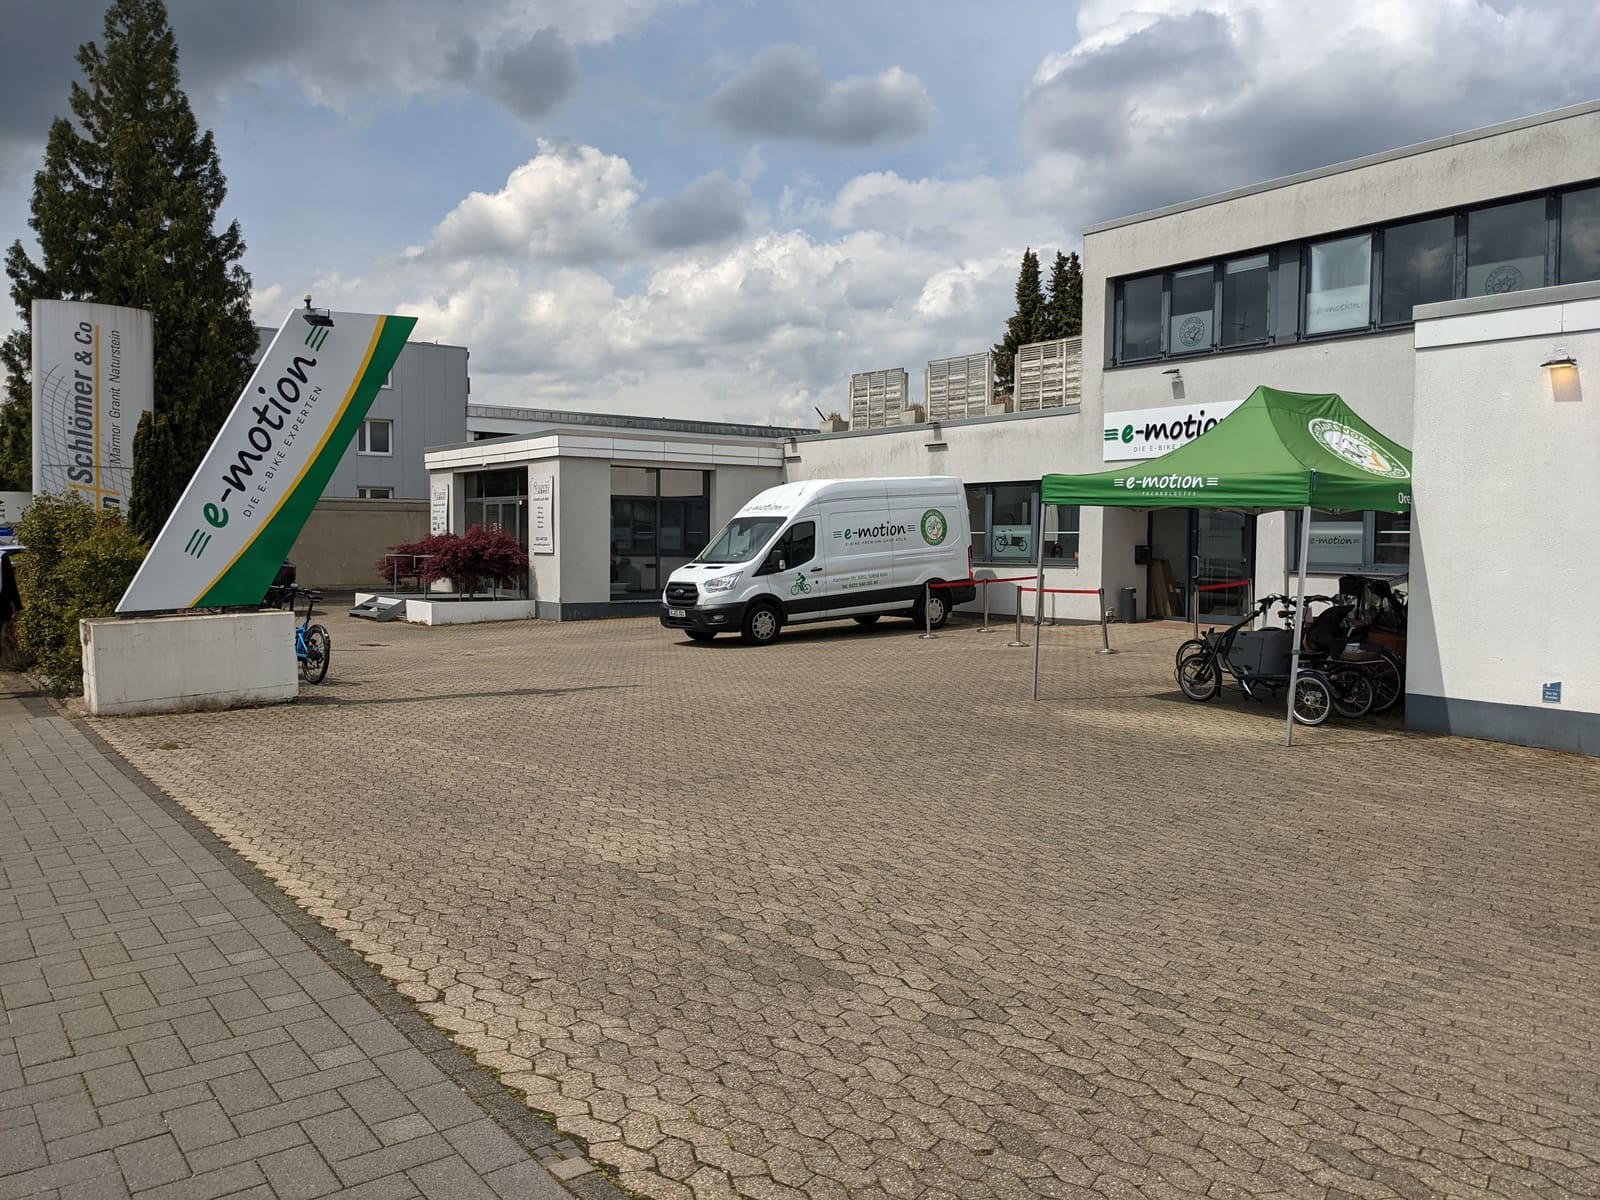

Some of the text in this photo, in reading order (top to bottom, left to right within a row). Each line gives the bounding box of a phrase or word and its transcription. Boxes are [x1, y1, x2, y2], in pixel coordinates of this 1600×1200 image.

[67, 321, 93, 484] Schlömer & Co
[108, 329, 121, 465] Marmor Granit Naturstein
[203, 356, 317, 529] e-motion
[1121, 409, 1223, 444] e-motio
[242, 385, 324, 518] DIE E-BIKE EXPERTEN
[1149, 443, 1177, 452] E-BIKE
[1126, 473, 1204, 489] e-motion
[844, 520, 906, 540] e-motion
[1310, 535, 1353, 545] e-motion
